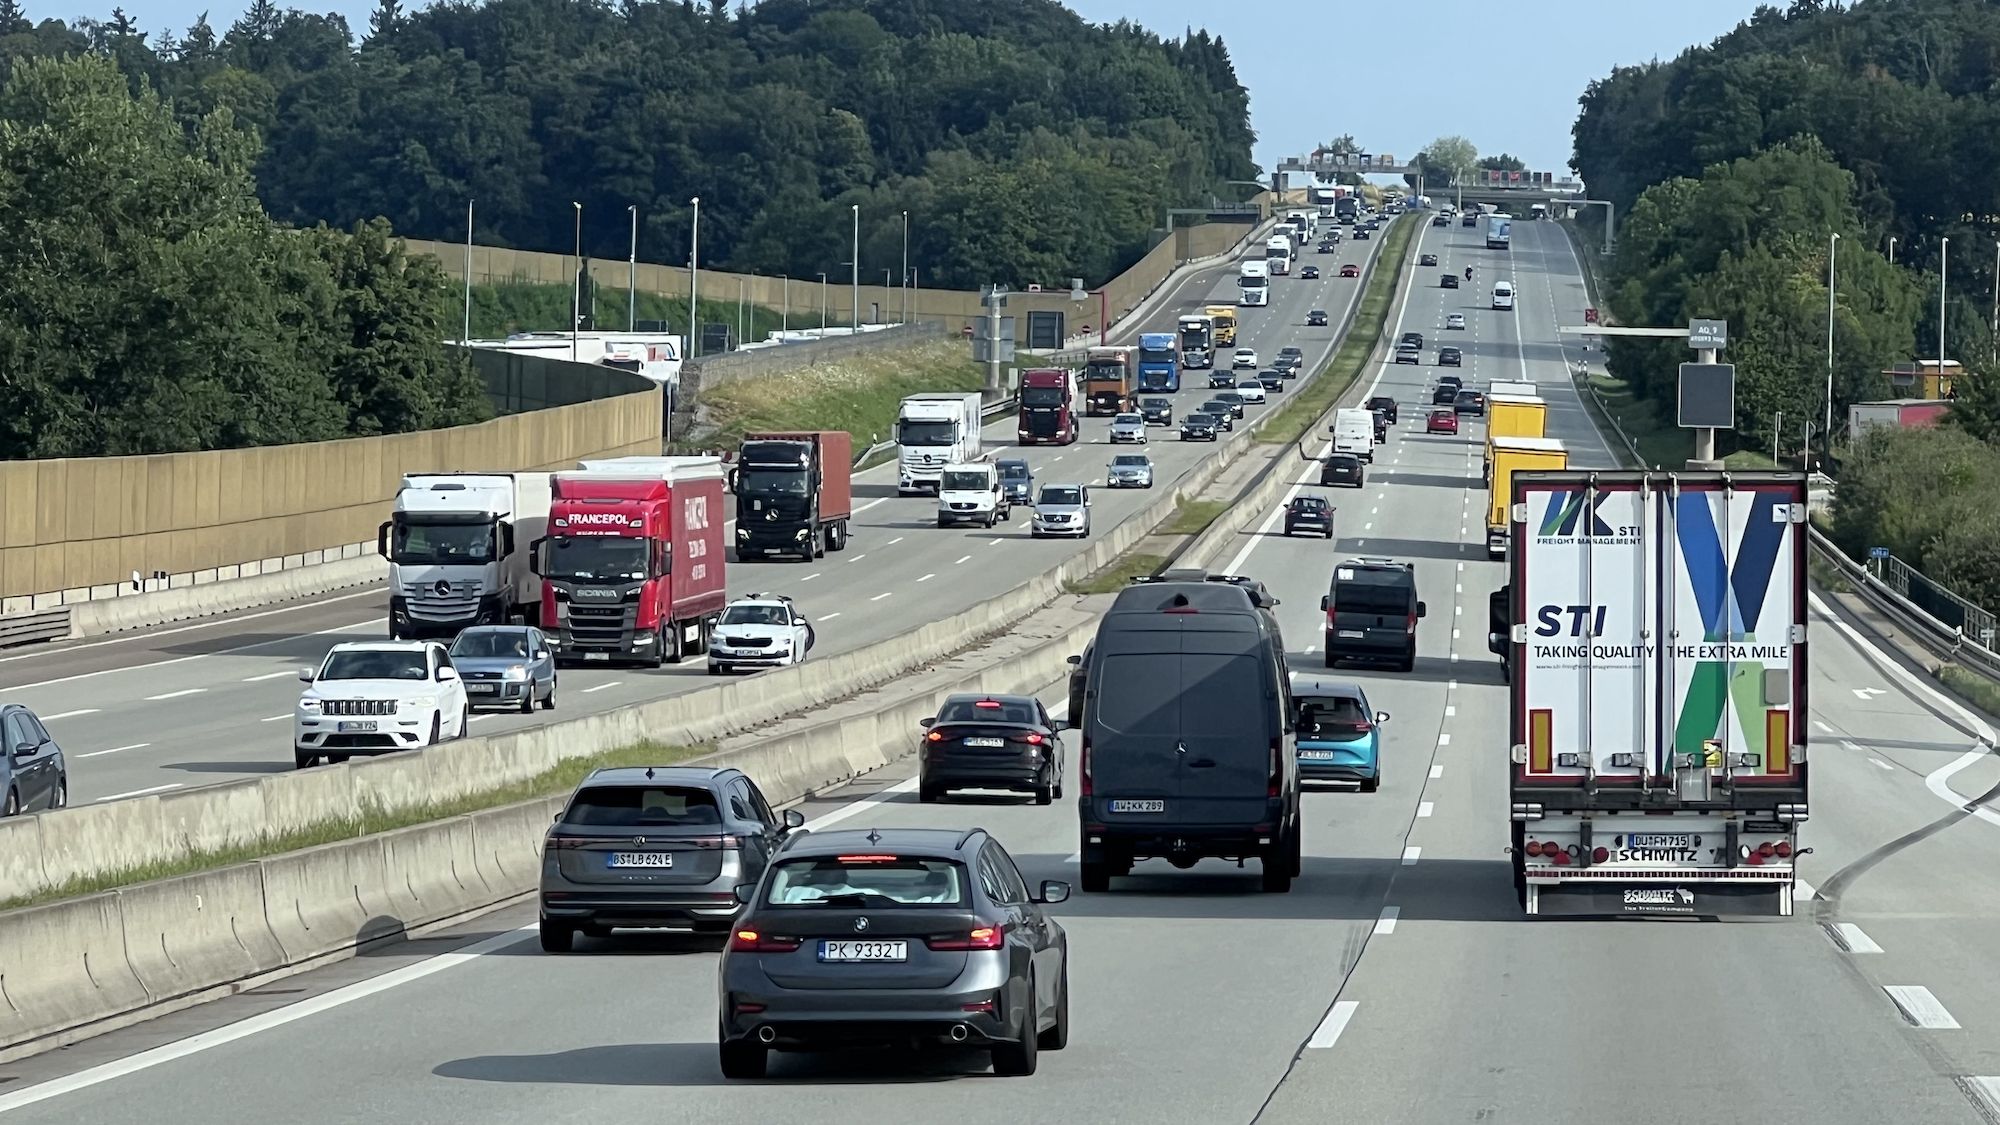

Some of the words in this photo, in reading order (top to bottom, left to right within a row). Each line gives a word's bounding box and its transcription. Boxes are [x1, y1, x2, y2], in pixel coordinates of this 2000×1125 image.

[568, 513, 629, 525] FRANCEPOL
[1619, 526, 1641, 536] STI
[577, 589, 617, 597] SCANIA
[1534, 605, 1607, 637] STI
[1534, 645, 1588, 658] TAKING
[1593, 645, 1655, 660] QUALITY
[1667, 645, 1695, 658] THE
[1699, 645, 1747, 658] EXTRA
[1752, 646, 1788, 658] MILE
[1669, 836, 1687, 846] 715
[1619, 849, 1698, 862] SCHMITZ
[828, 943, 848, 958] PK
[854, 943, 903, 958] 9332T
